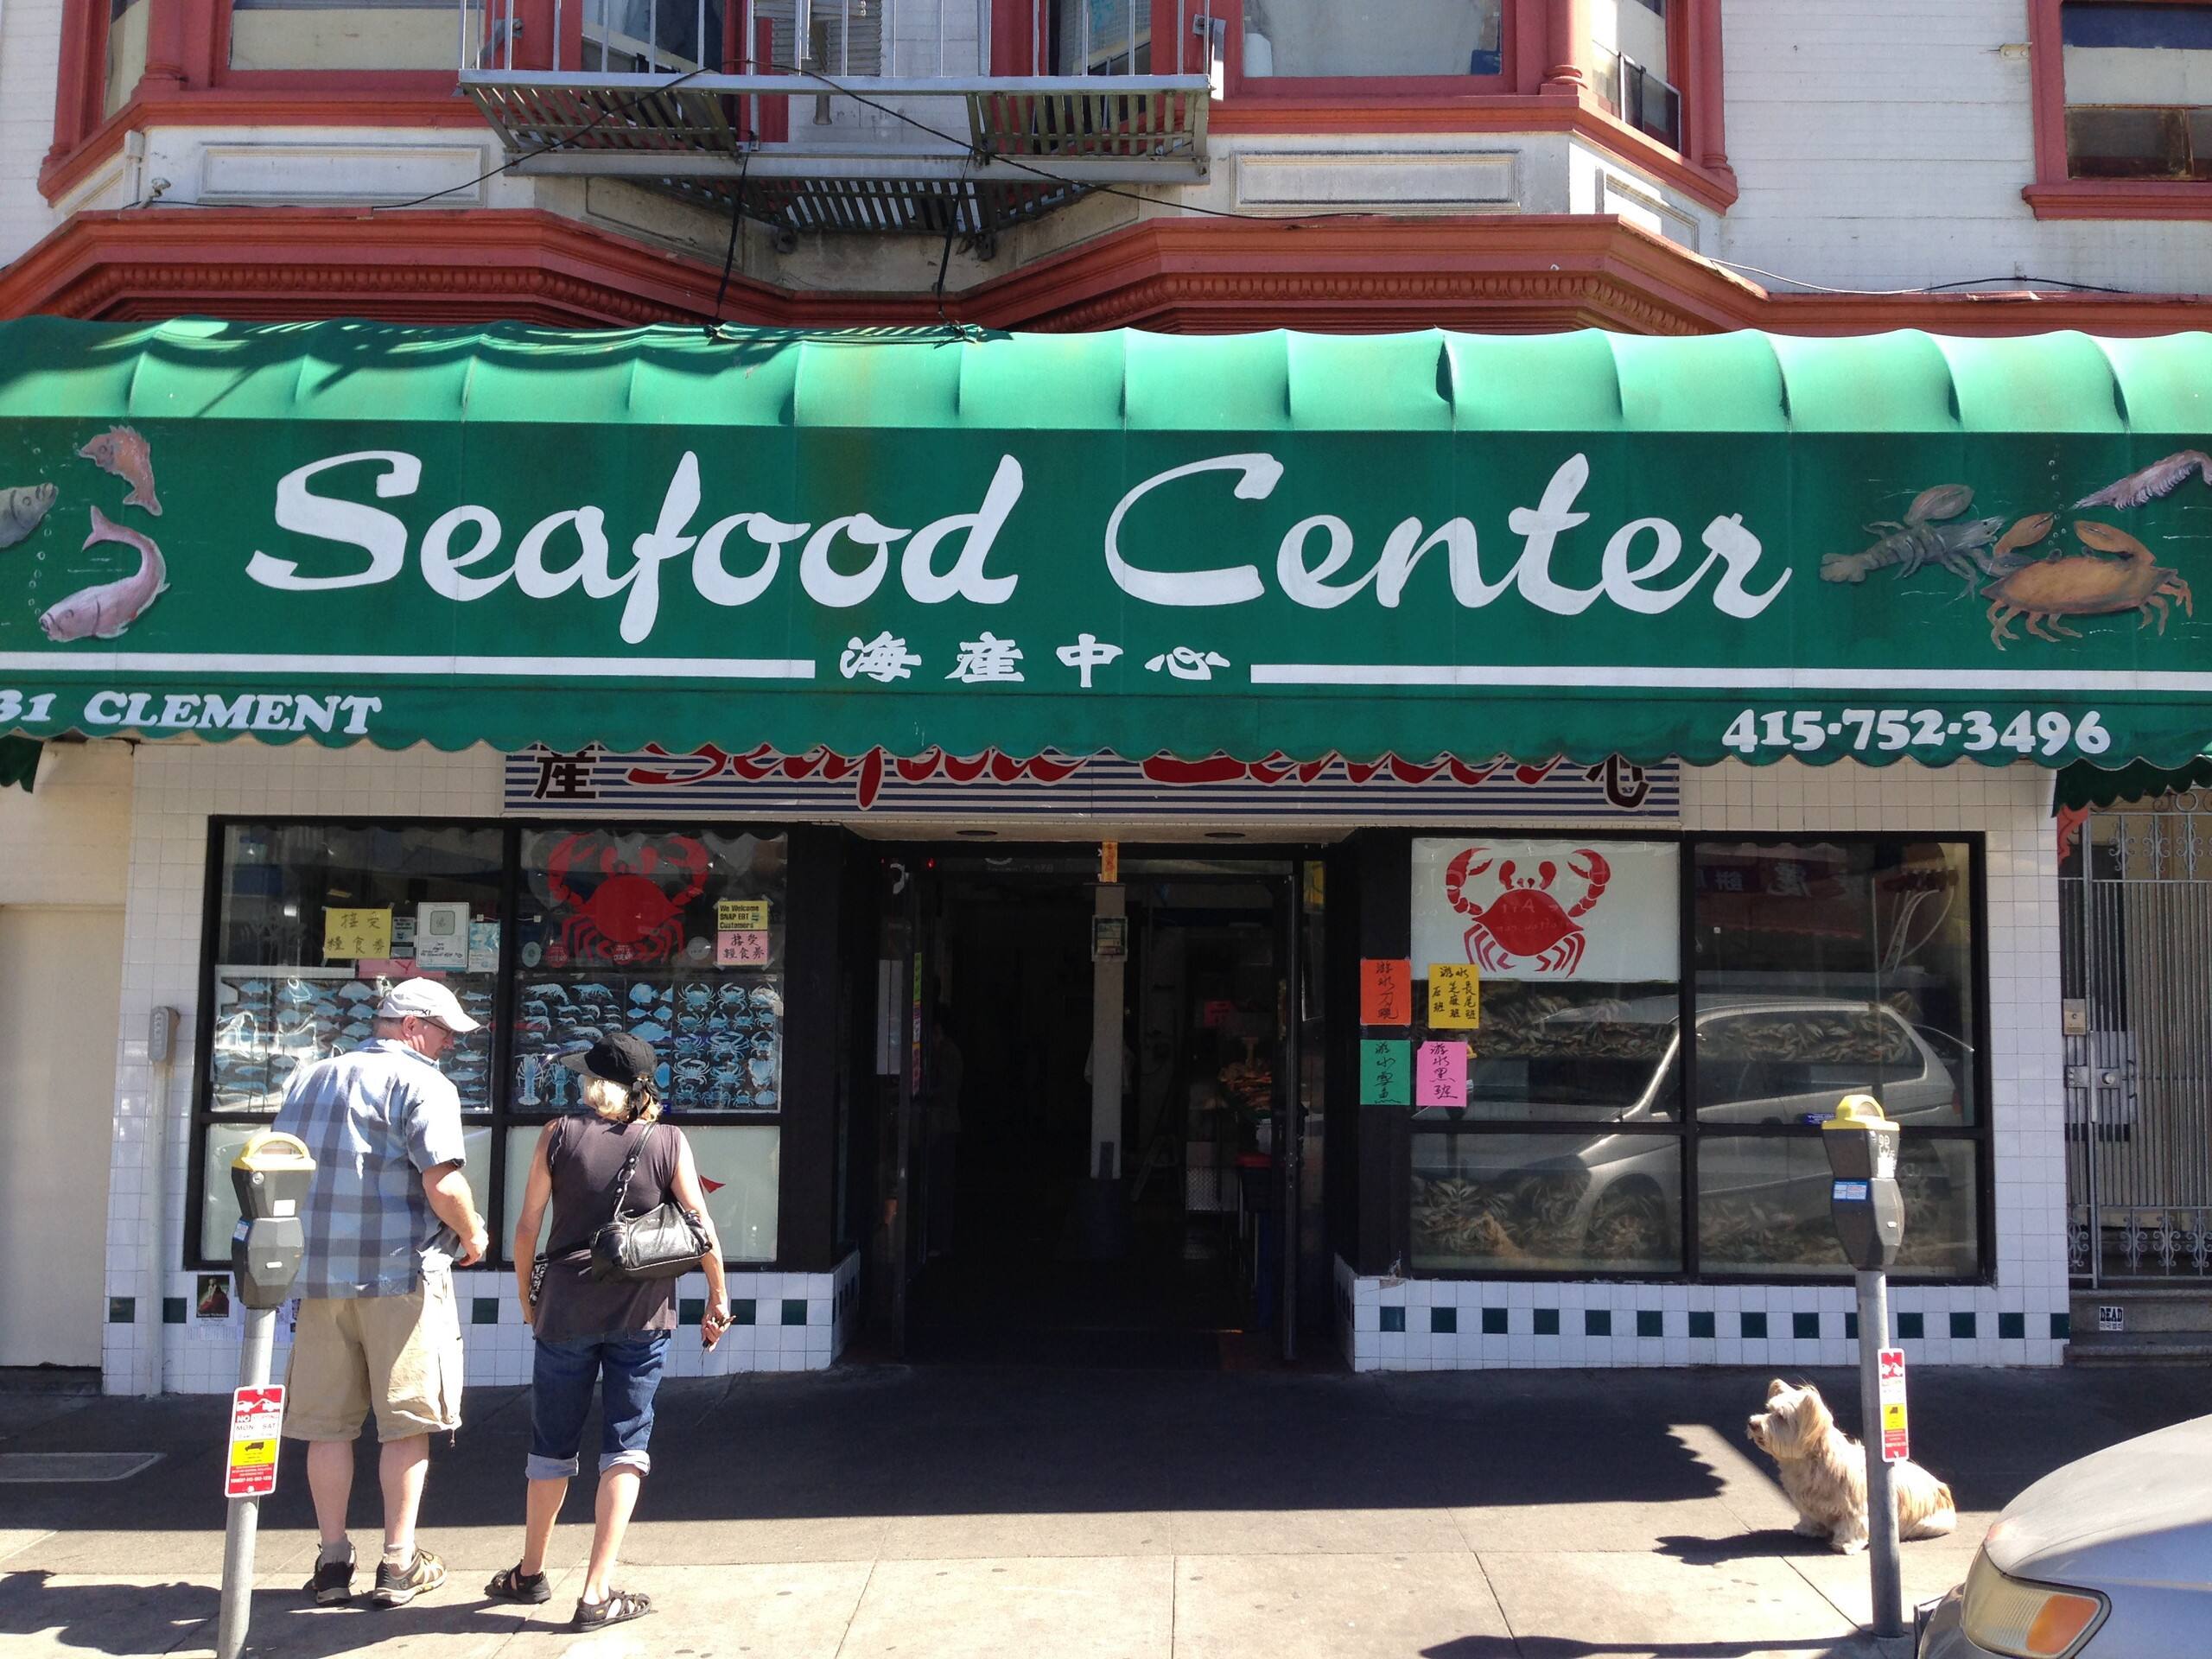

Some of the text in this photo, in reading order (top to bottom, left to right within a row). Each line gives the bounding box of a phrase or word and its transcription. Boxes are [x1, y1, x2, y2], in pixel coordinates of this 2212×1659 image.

[245, 450, 1792, 645] Seafood Center
[84, 690, 382, 734] CLEMENT
[1722, 709, 2110, 753] 415-752-3496
[2100, 1307, 2123, 1322] DEAD
